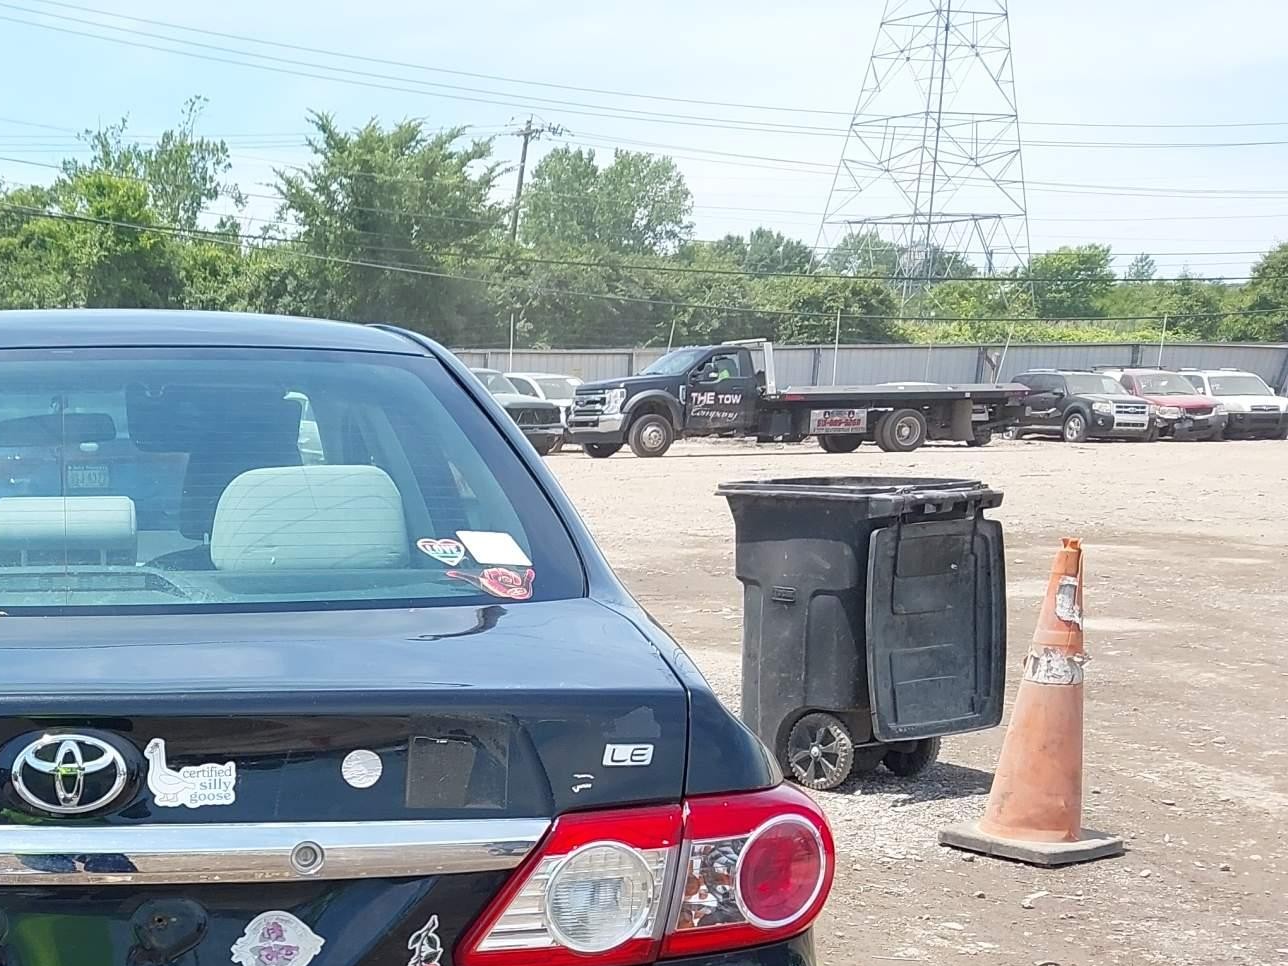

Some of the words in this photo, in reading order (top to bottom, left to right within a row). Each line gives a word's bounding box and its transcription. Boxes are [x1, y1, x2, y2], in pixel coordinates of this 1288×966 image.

[691, 392, 715, 404] THE
[718, 394, 742, 404] TOW
[606, 745, 652, 765] LE
[183, 766, 232, 778] certified
[199, 778, 231, 791] silly
[190, 792, 231, 803] goose
